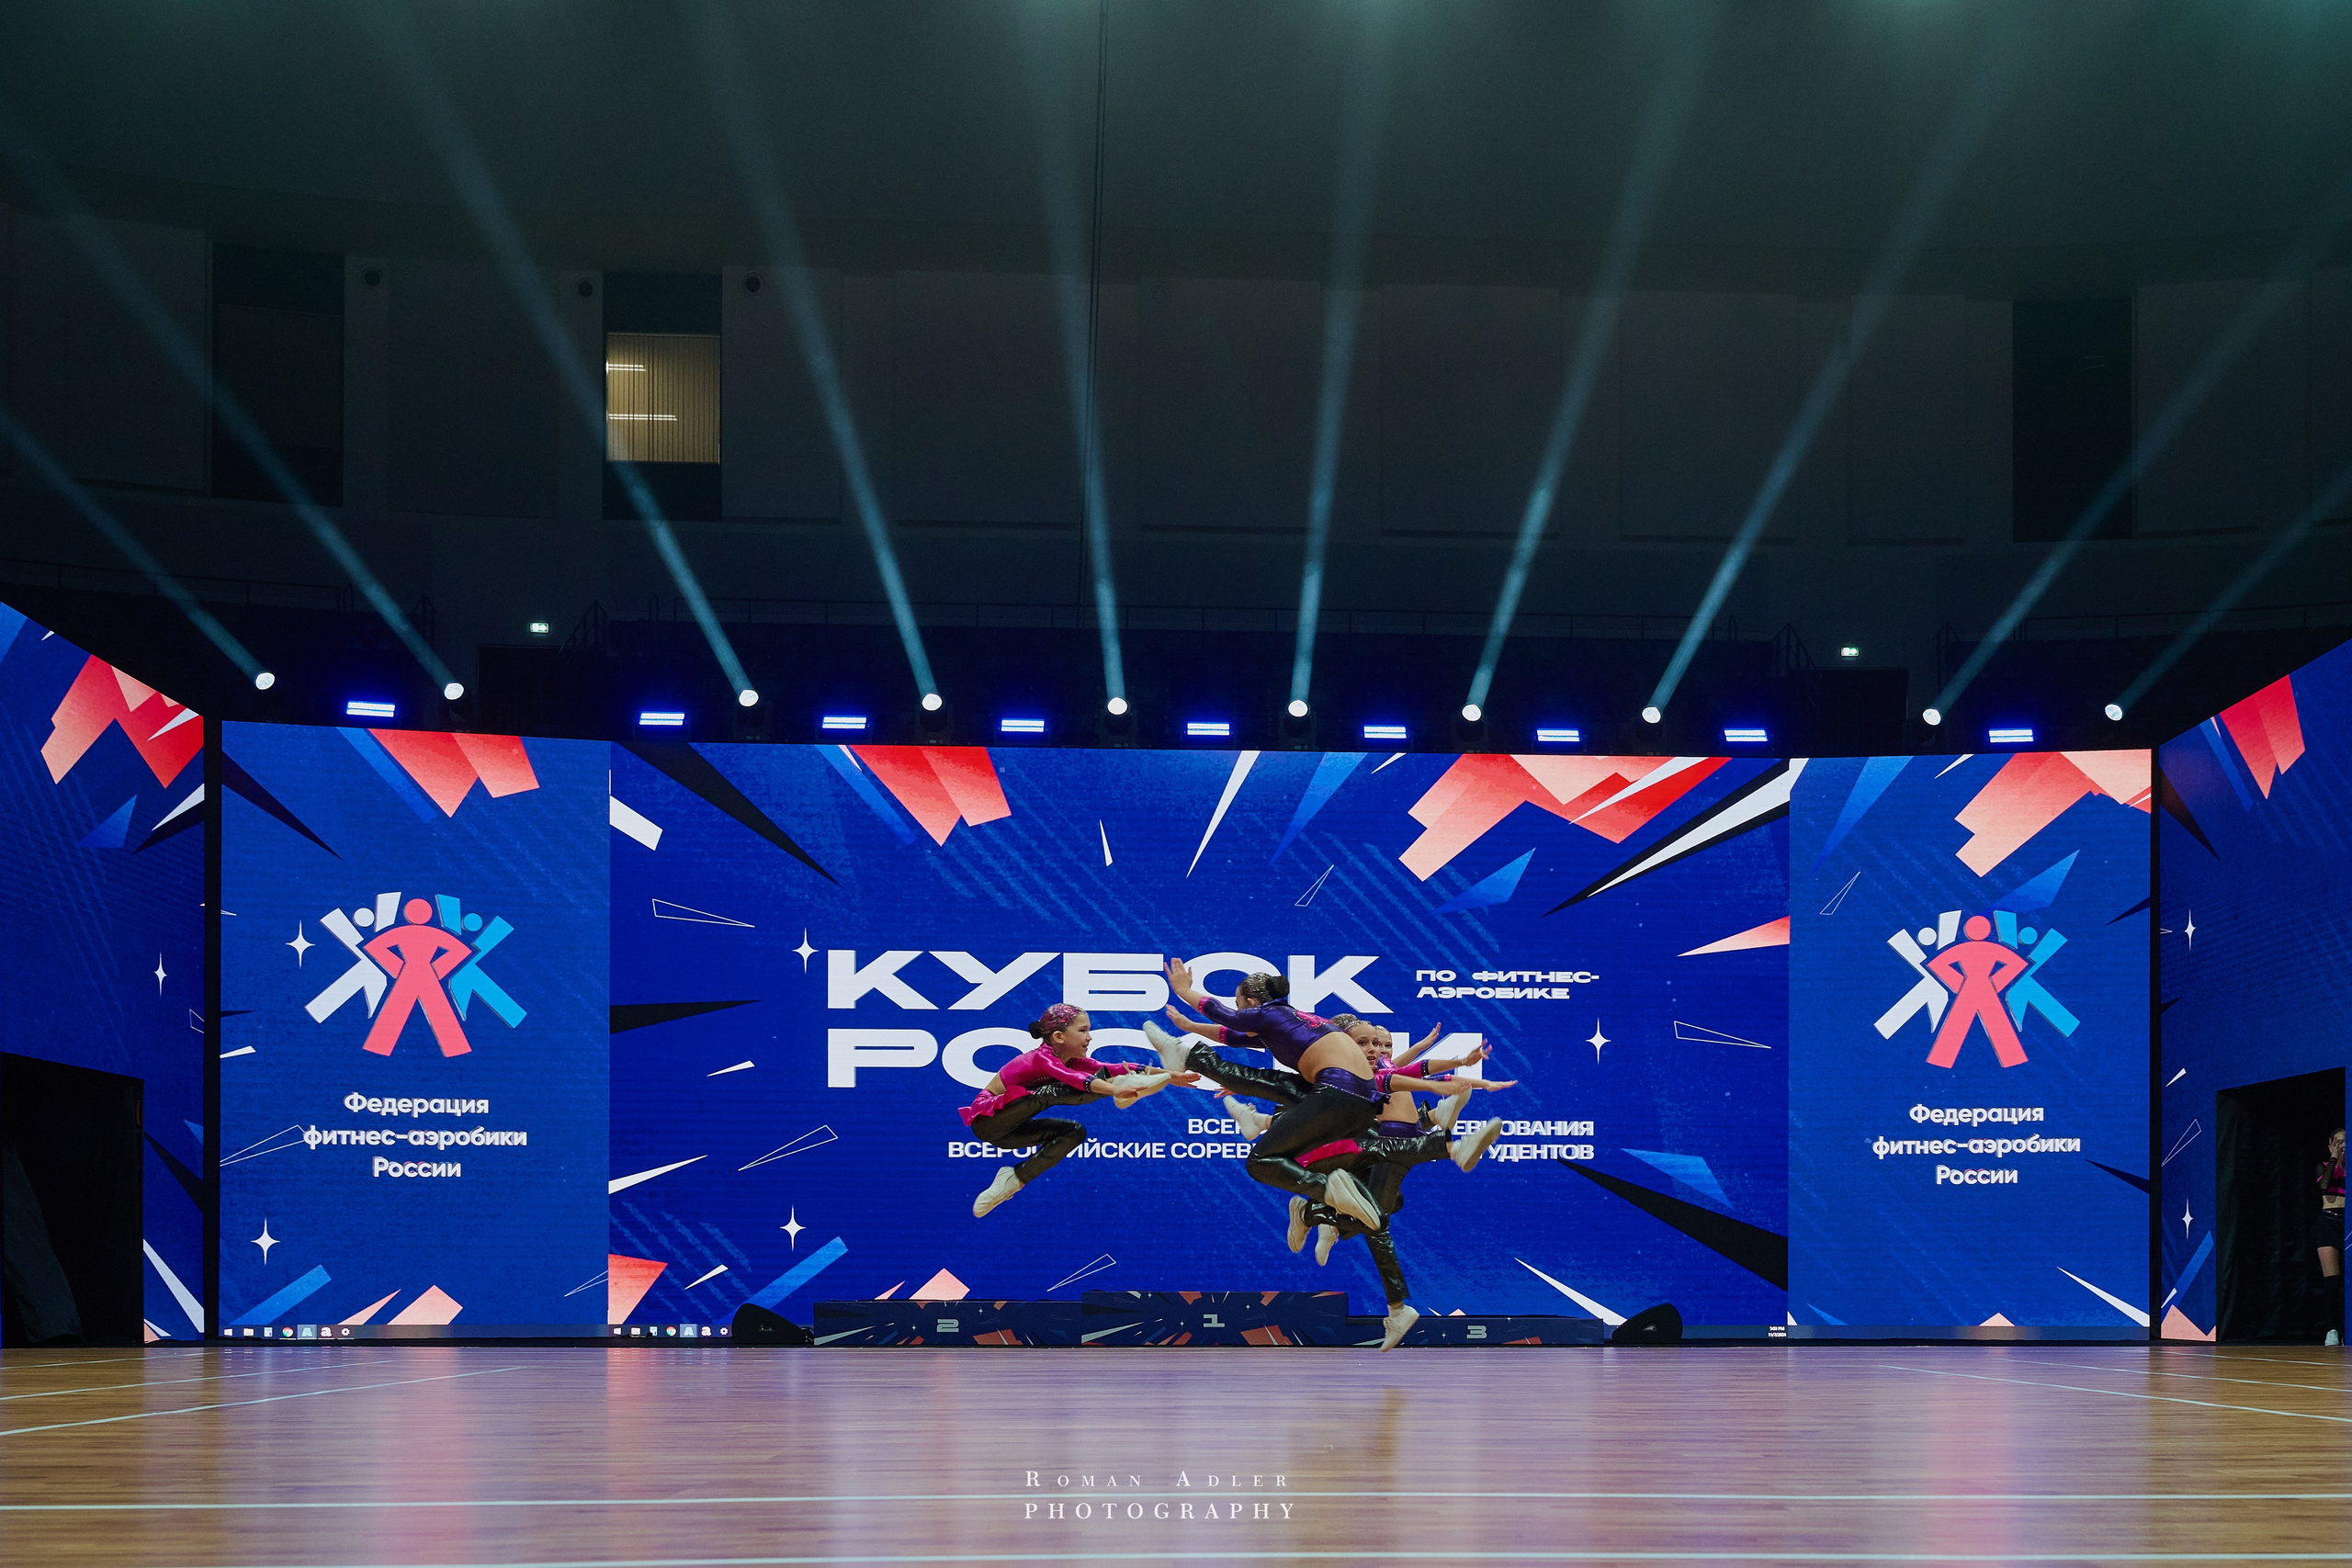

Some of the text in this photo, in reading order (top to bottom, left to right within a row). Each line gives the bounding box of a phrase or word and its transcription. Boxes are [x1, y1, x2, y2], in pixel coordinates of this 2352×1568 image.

[828, 950, 1394, 1013] КУБОК
[1416, 969, 1600, 983] ПО ФИТНЕС-
[1416, 986, 1570, 999] АЭРОБИКЕ
[344, 1092, 489, 1118] Федерация
[1909, 1103, 2044, 1127] Федерация
[303, 1125, 527, 1150] фитнес-аэробики
[1872, 1134, 2081, 1159] фитнес-аэробики
[372, 1156, 461, 1178] России
[1936, 1165, 2018, 1185] России
[937, 1318, 959, 1332] 2
[1204, 1314, 1225, 1327] 1
[1466, 1325, 1487, 1338] 3
